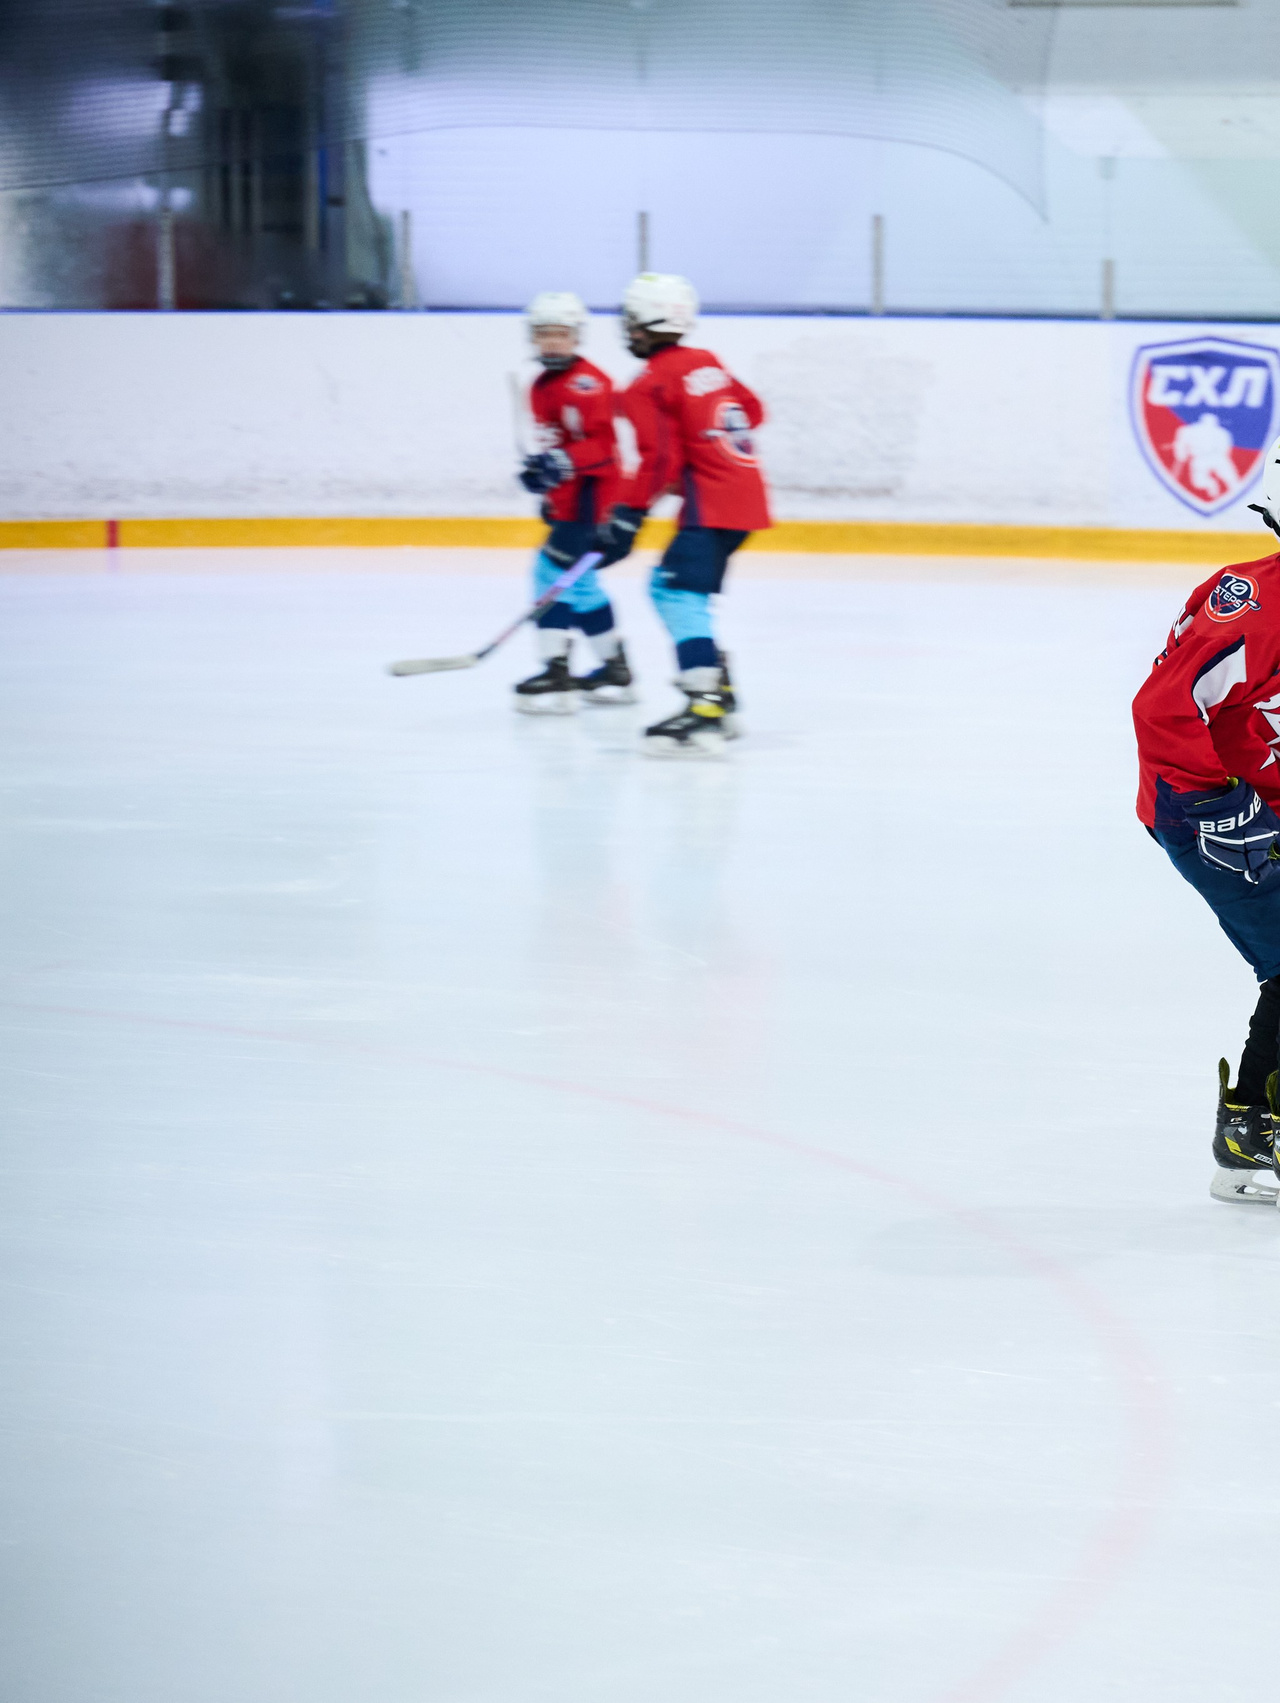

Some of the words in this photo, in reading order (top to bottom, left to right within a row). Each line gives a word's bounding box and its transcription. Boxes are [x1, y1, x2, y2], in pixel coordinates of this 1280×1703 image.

[1148, 364, 1268, 408] СХЛ
[1214, 585, 1243, 608] STEPS
[1224, 577, 1248, 596] 10
